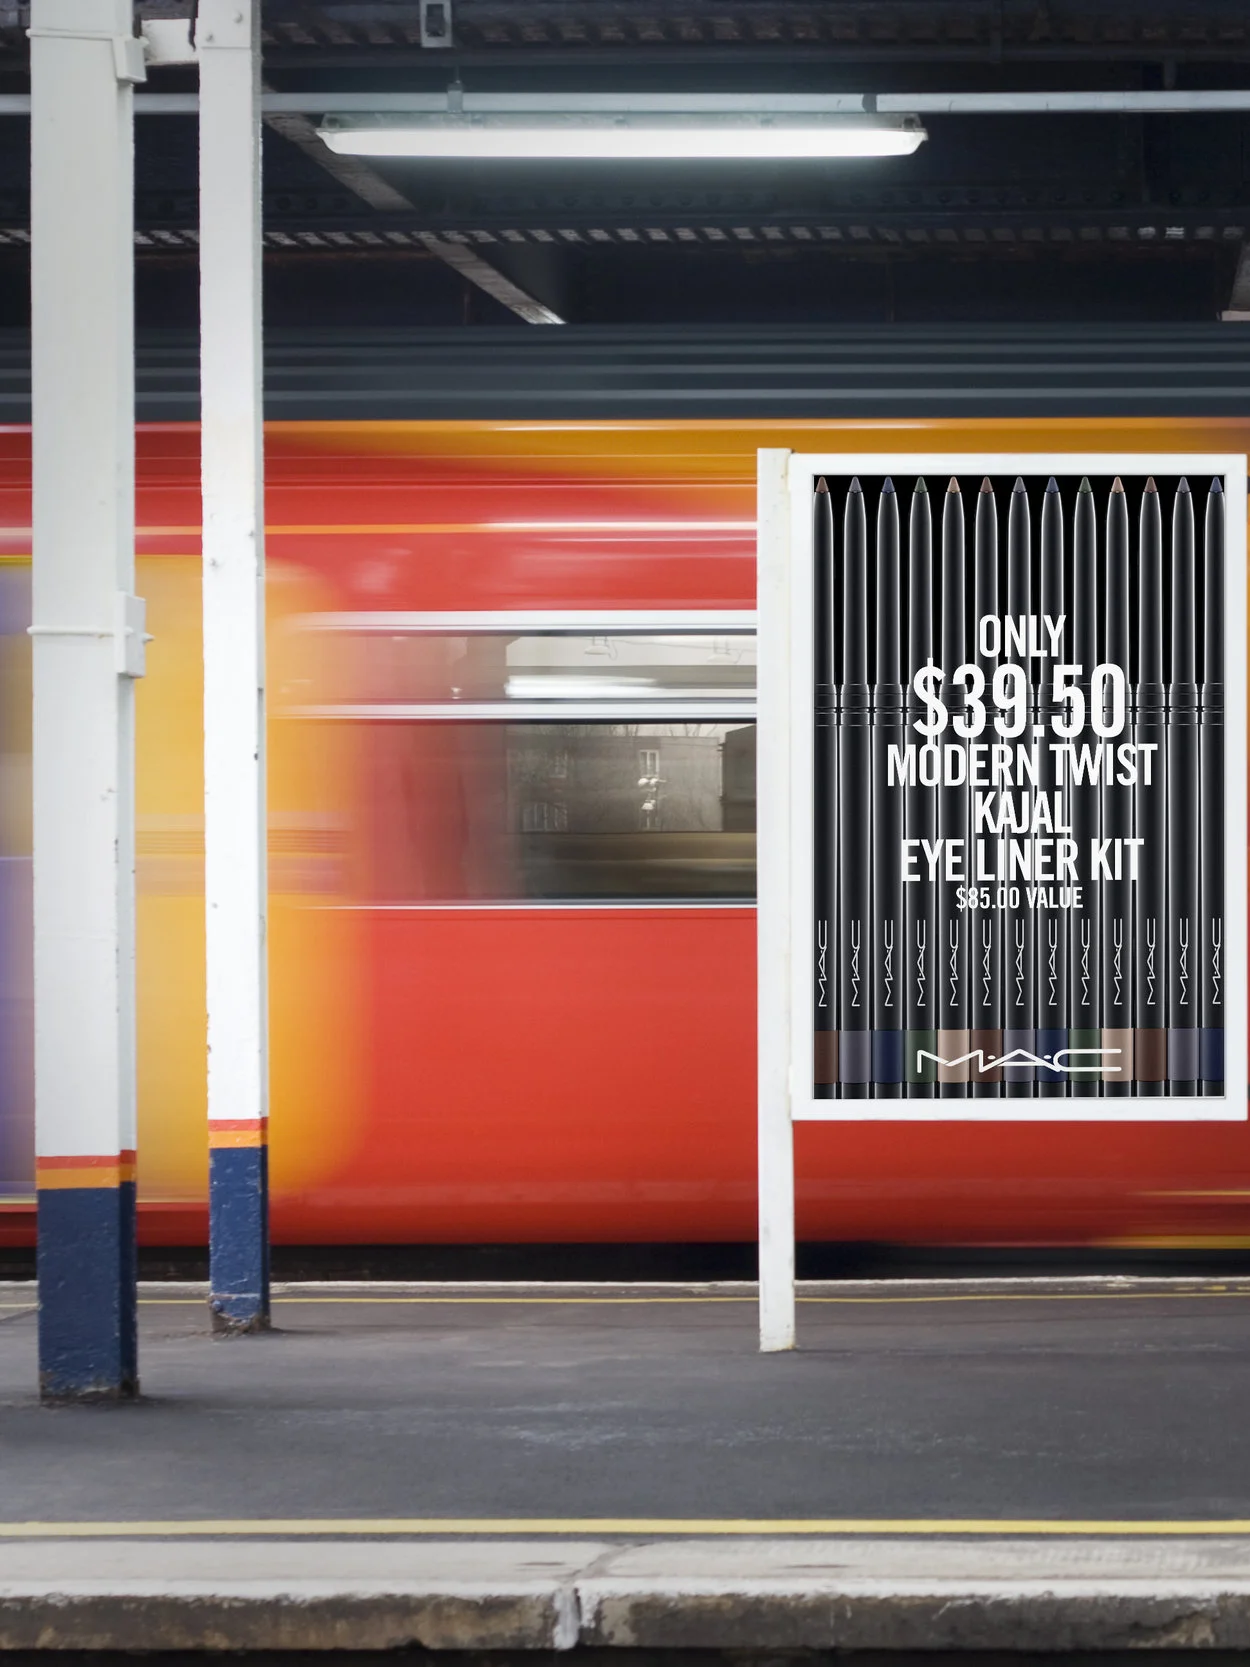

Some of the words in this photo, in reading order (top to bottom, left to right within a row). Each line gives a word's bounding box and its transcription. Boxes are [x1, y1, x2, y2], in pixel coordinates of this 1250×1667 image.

[979, 614, 1067, 658] ONLY
[912, 657, 1126, 746] $39.50
[887, 743, 1039, 788] MODERN
[1049, 743, 1158, 788] TWIST
[974, 790, 1073, 834] KAJAL
[901, 838, 966, 882] EYE
[976, 838, 1079, 882] LINER
[1090, 838, 1145, 882] KIT
[955, 885, 1020, 913] $85.00
[1026, 887, 1084, 909] VALUE
